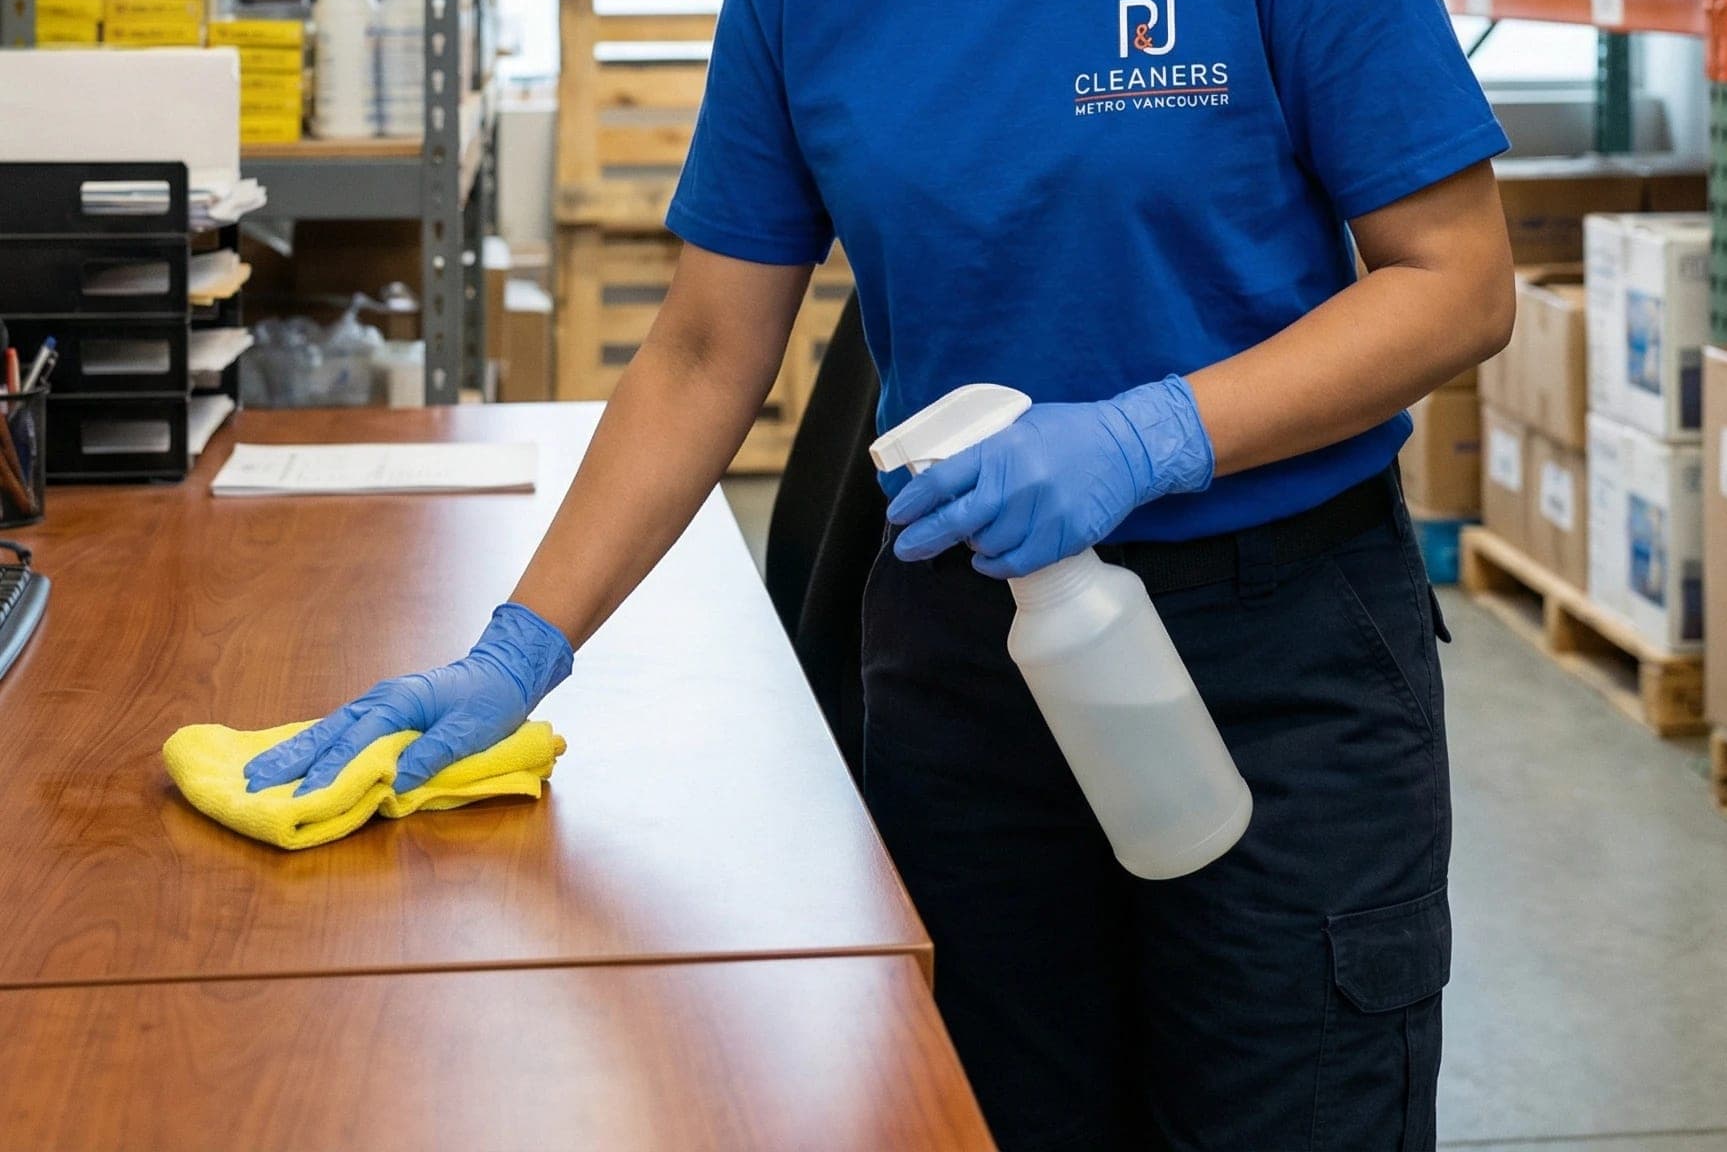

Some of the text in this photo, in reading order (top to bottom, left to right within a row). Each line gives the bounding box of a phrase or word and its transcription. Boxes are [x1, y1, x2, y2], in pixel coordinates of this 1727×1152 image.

[1074, 62, 1229, 95] CLEANERS
[1075, 94, 1230, 116] METRO VANCOUVER
